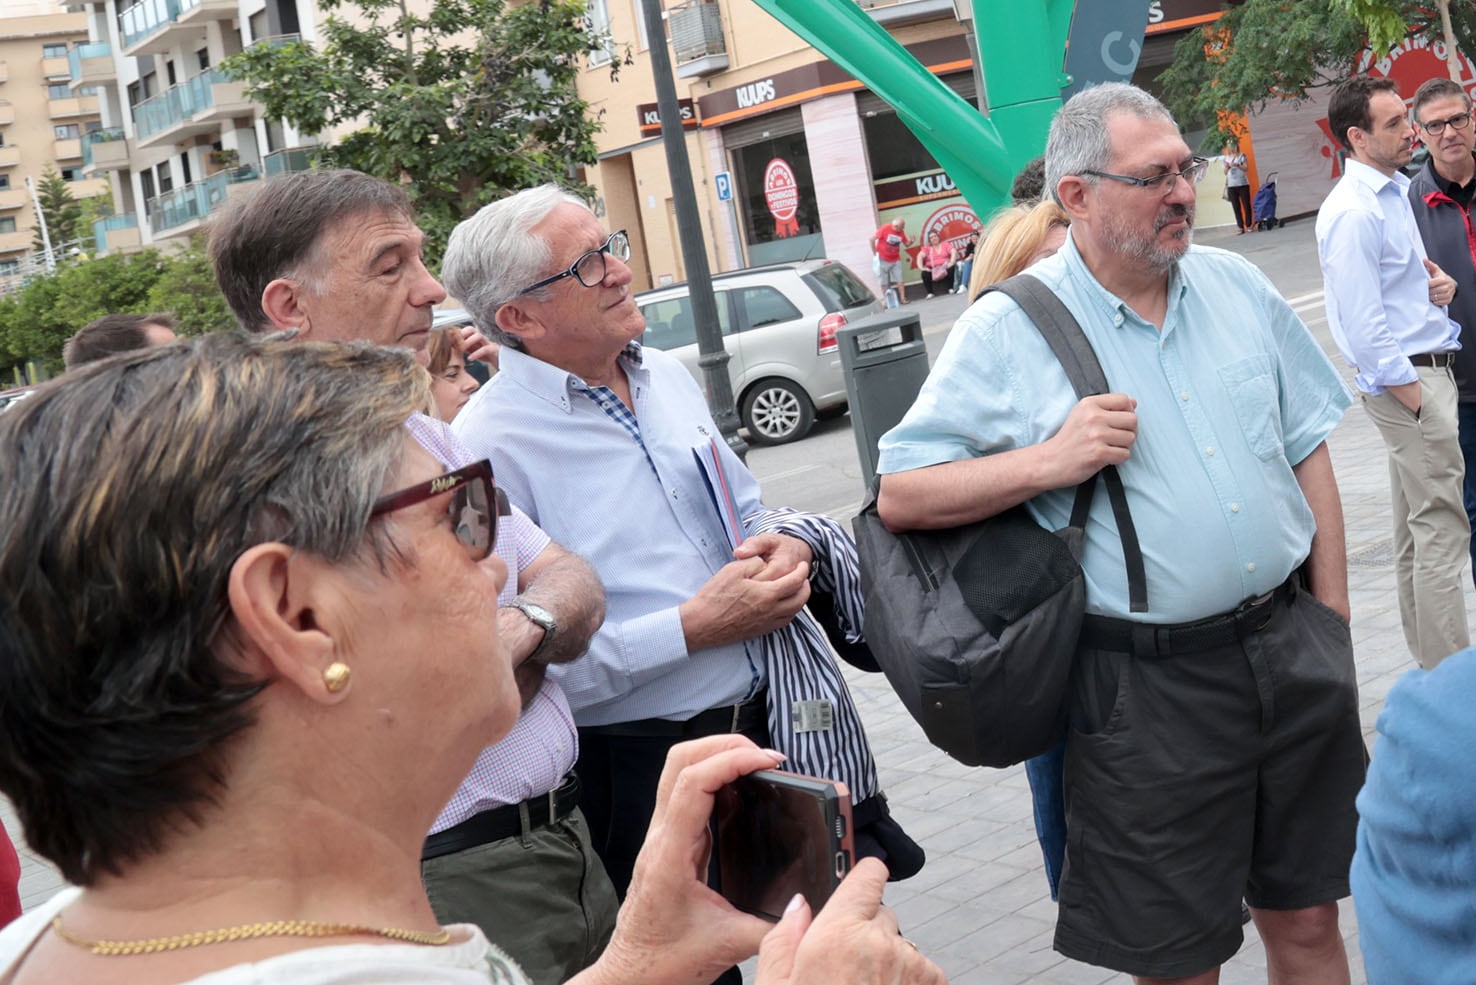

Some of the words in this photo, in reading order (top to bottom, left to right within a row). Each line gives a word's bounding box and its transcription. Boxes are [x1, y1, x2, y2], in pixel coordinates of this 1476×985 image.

[736, 79, 776, 108] KUUPS
[717, 177, 727, 199] P
[915, 173, 957, 195] KUU
[934, 212, 980, 232] BRIMOS
